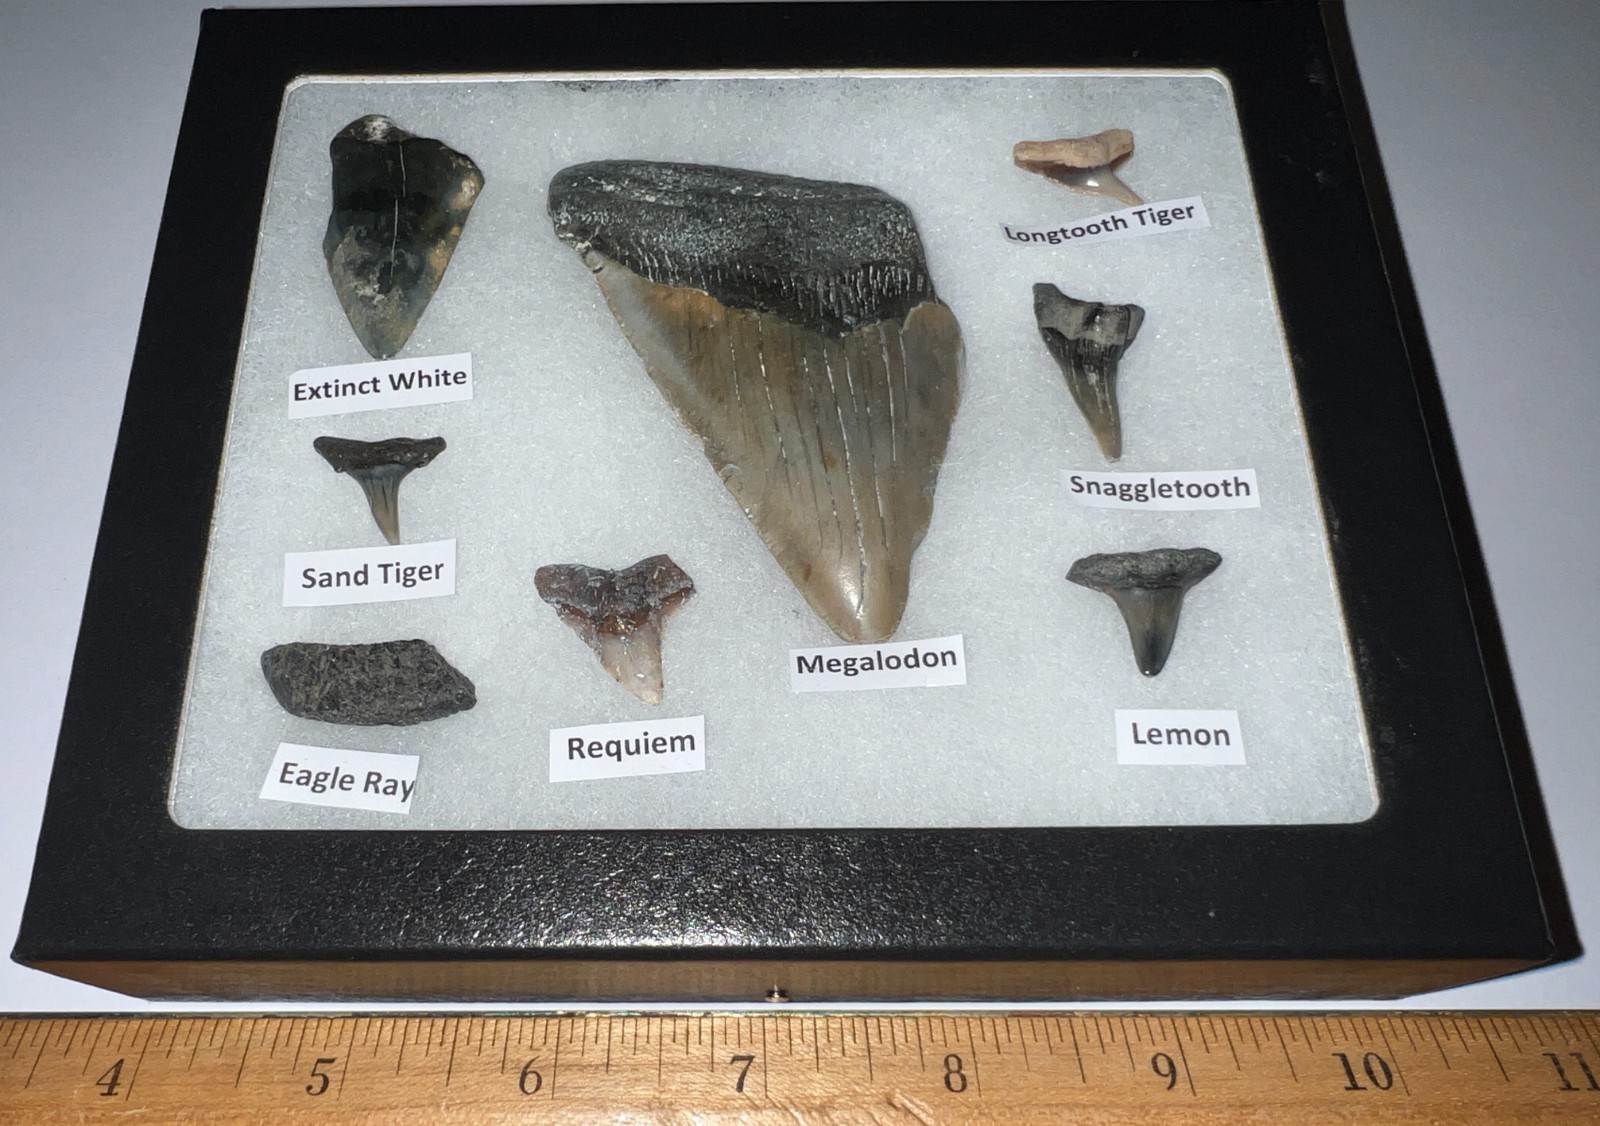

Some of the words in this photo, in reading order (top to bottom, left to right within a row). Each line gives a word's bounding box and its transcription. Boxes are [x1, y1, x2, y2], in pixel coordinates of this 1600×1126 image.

[1003, 214, 1129, 245] Longtooth
[1132, 204, 1196, 227] Tiger
[293, 375, 381, 402] Extinct
[388, 367, 468, 391] White
[1069, 475, 1252, 503] Snaggletooth
[301, 563, 370, 590] Sand
[377, 560, 445, 589] Tiger
[796, 647, 958, 677] Megalodon
[567, 729, 697, 762] Requiem
[1131, 722, 1231, 747] Lemon
[278, 761, 356, 795] Eagle
[363, 771, 416, 804] Ray
[95, 1057, 125, 1097] 4
[305, 1056, 338, 1096] 5
[518, 1056, 544, 1096] 6
[729, 1053, 757, 1094] 7
[942, 1052, 968, 1093] 8
[1150, 1052, 1178, 1091] 9
[1331, 1052, 1393, 1091] 10
[1541, 1051, 1600, 1092] 11
